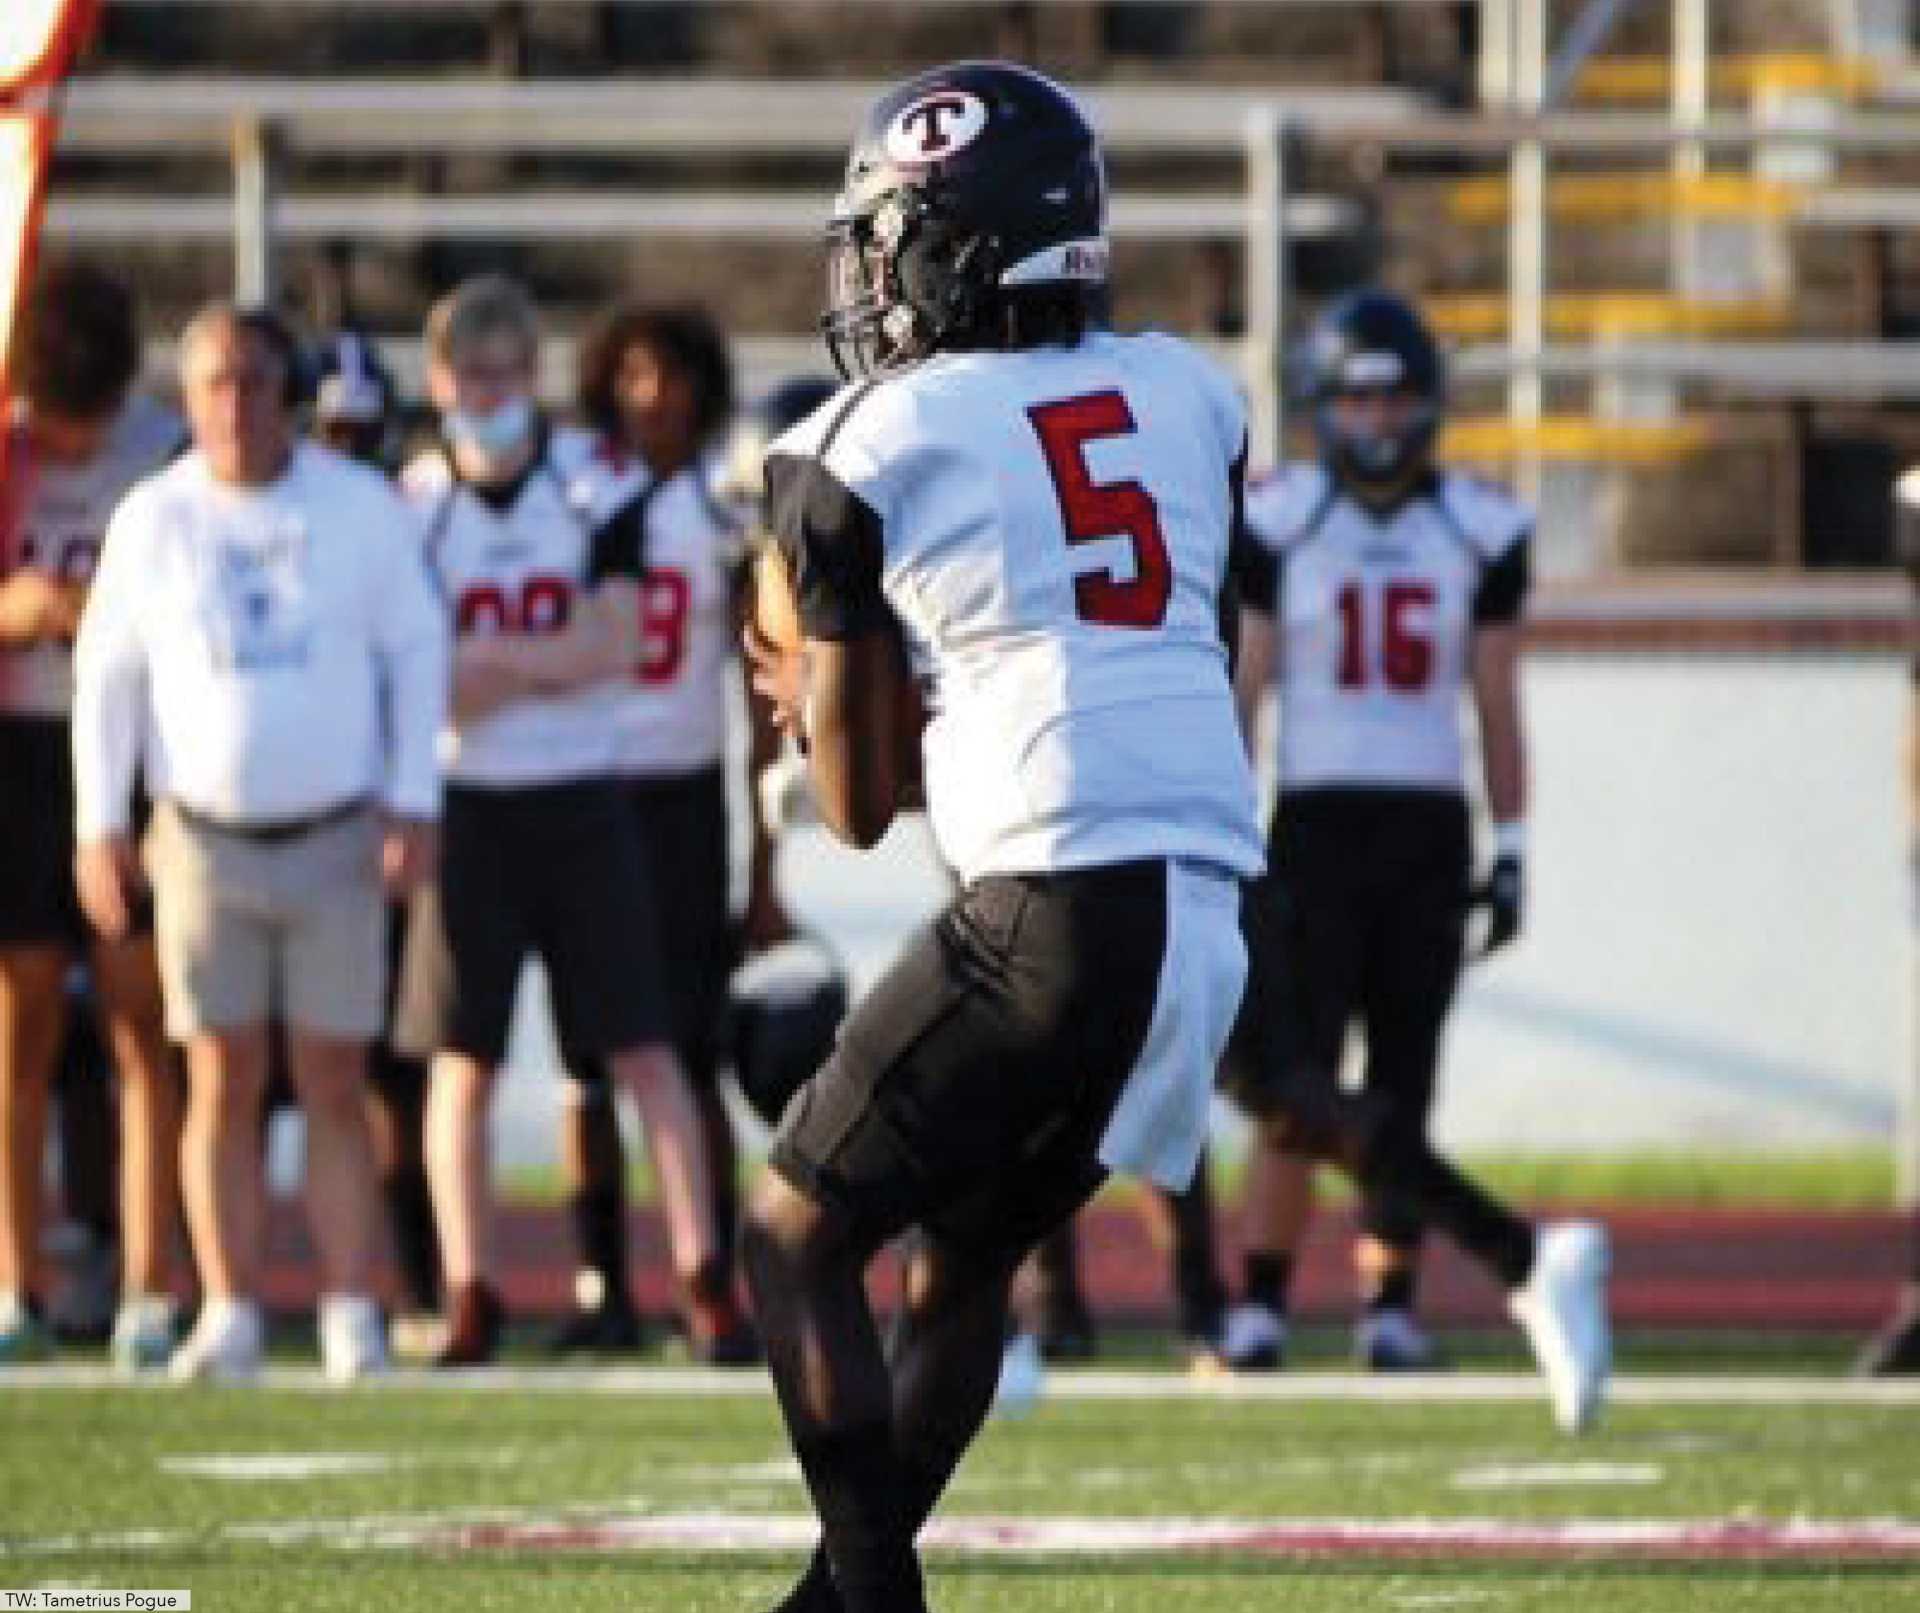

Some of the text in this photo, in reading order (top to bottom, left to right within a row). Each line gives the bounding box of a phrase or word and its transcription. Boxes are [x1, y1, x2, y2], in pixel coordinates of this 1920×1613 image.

[902, 98, 965, 151] T
[1027, 386, 1173, 630] 5
[1338, 581, 1438, 694] 16
